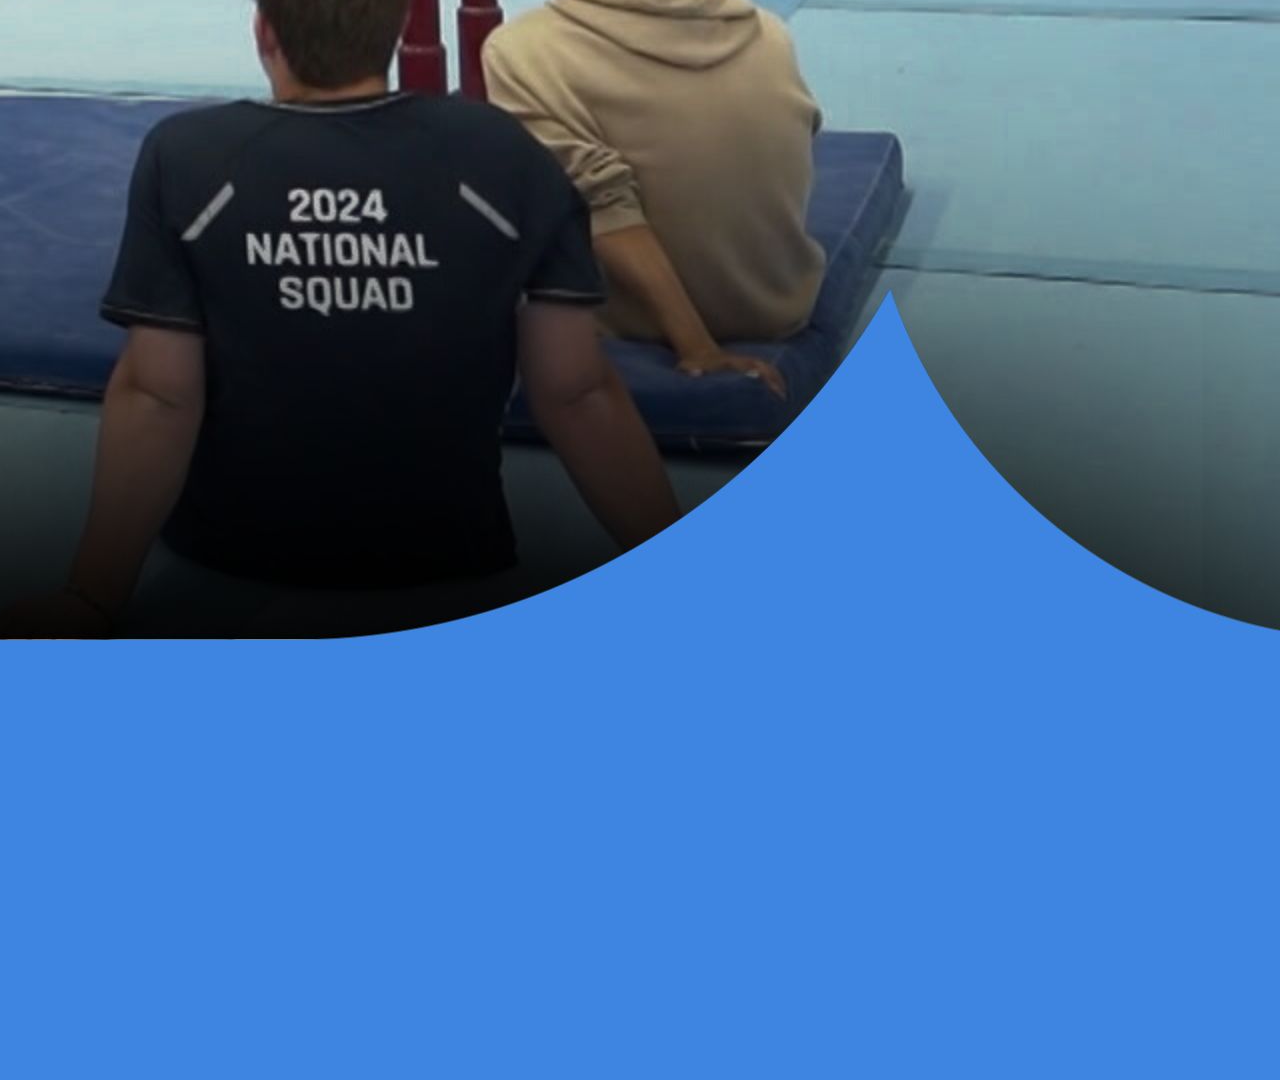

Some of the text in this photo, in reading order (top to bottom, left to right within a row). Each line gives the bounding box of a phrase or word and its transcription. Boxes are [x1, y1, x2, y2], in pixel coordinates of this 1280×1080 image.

[287, 187, 388, 223] 2024
[246, 232, 438, 267] NATIONAL
[278, 276, 414, 315] SQUAD
